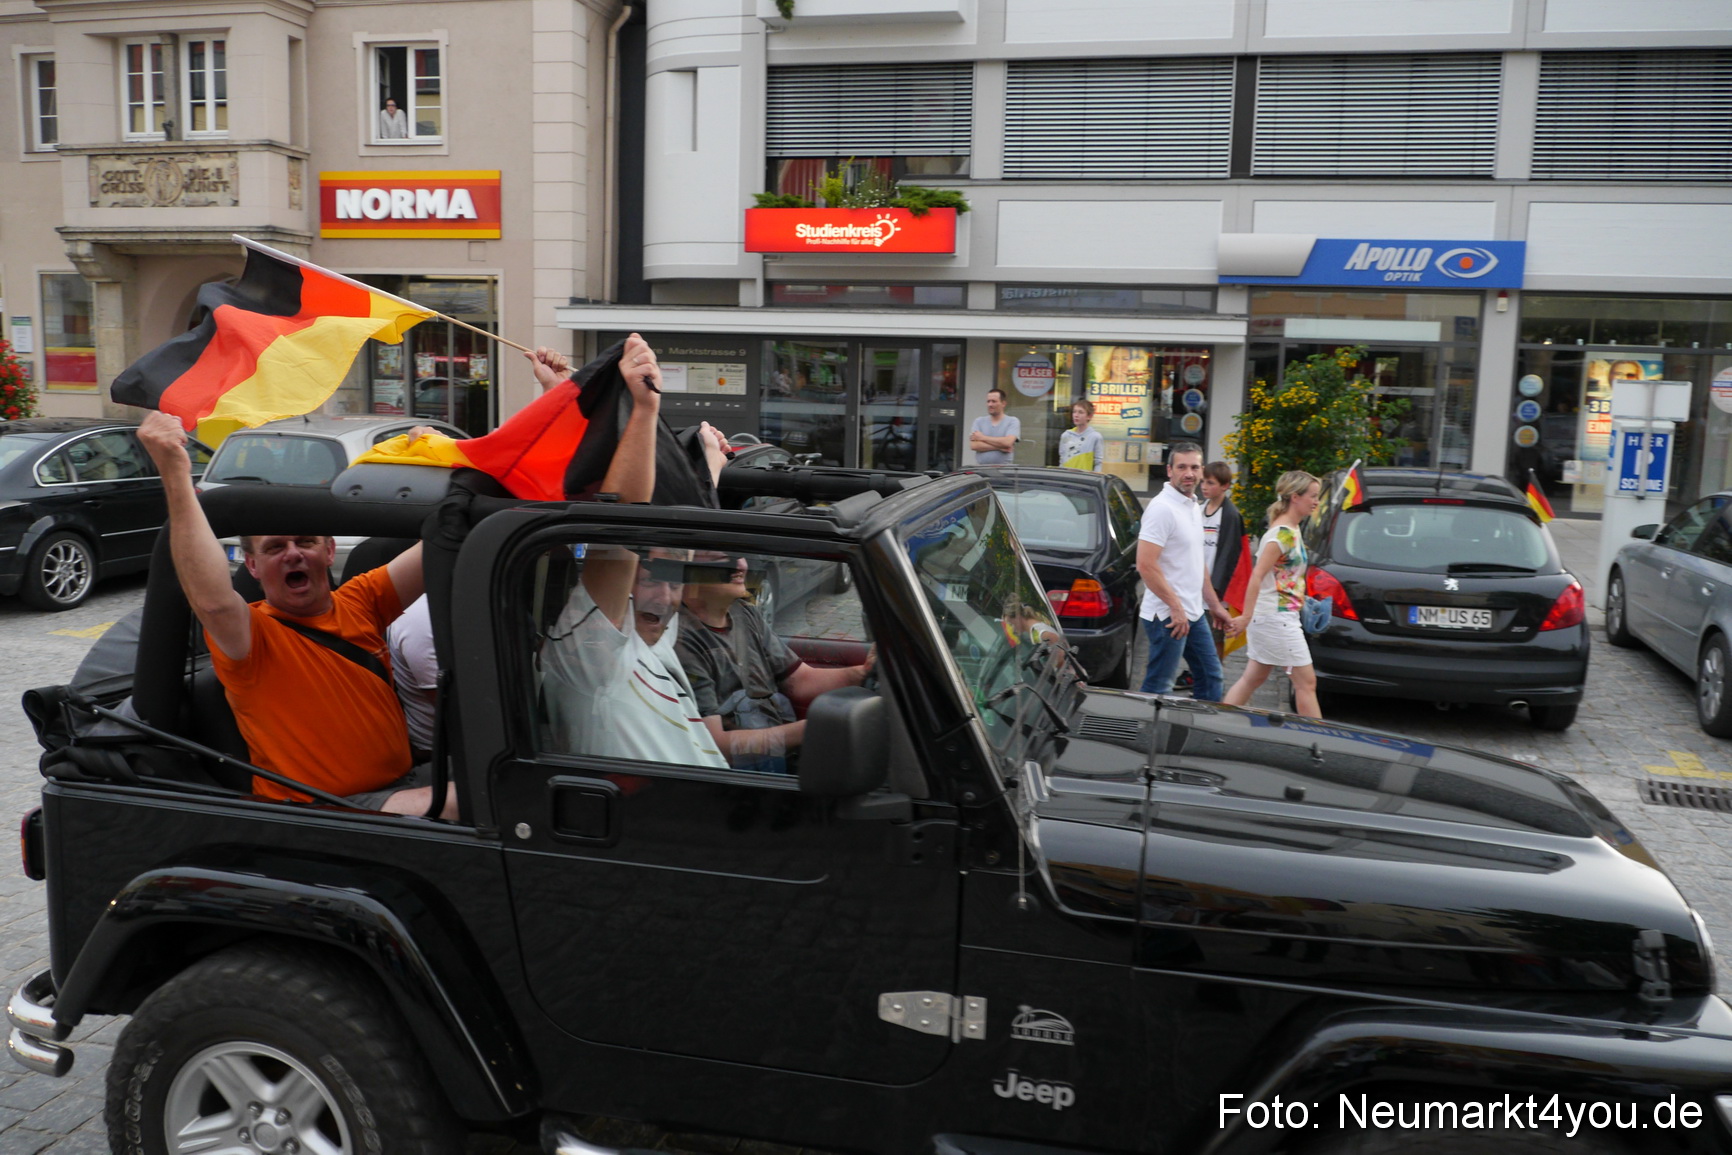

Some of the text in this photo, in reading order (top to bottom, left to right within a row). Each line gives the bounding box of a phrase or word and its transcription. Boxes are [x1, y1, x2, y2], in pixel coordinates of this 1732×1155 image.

[336, 188, 477, 220] NORMA
[796, 223, 883, 238] Studienkreis
[1344, 243, 1433, 271] APOLLO
[1383, 272, 1423, 282] OPTIK
[668, 347, 736, 356] Marktstrasse
[739, 348, 746, 356] 9
[1020, 367, 1052, 377] GLÄSER
[1091, 383, 1147, 396] 3 BRILLEN
[1590, 400, 1599, 412] 3
[1587, 421, 1611, 433] EIN
[1418, 608, 1490, 625] NM US 65
[993, 1072, 1075, 1111] Jeep
